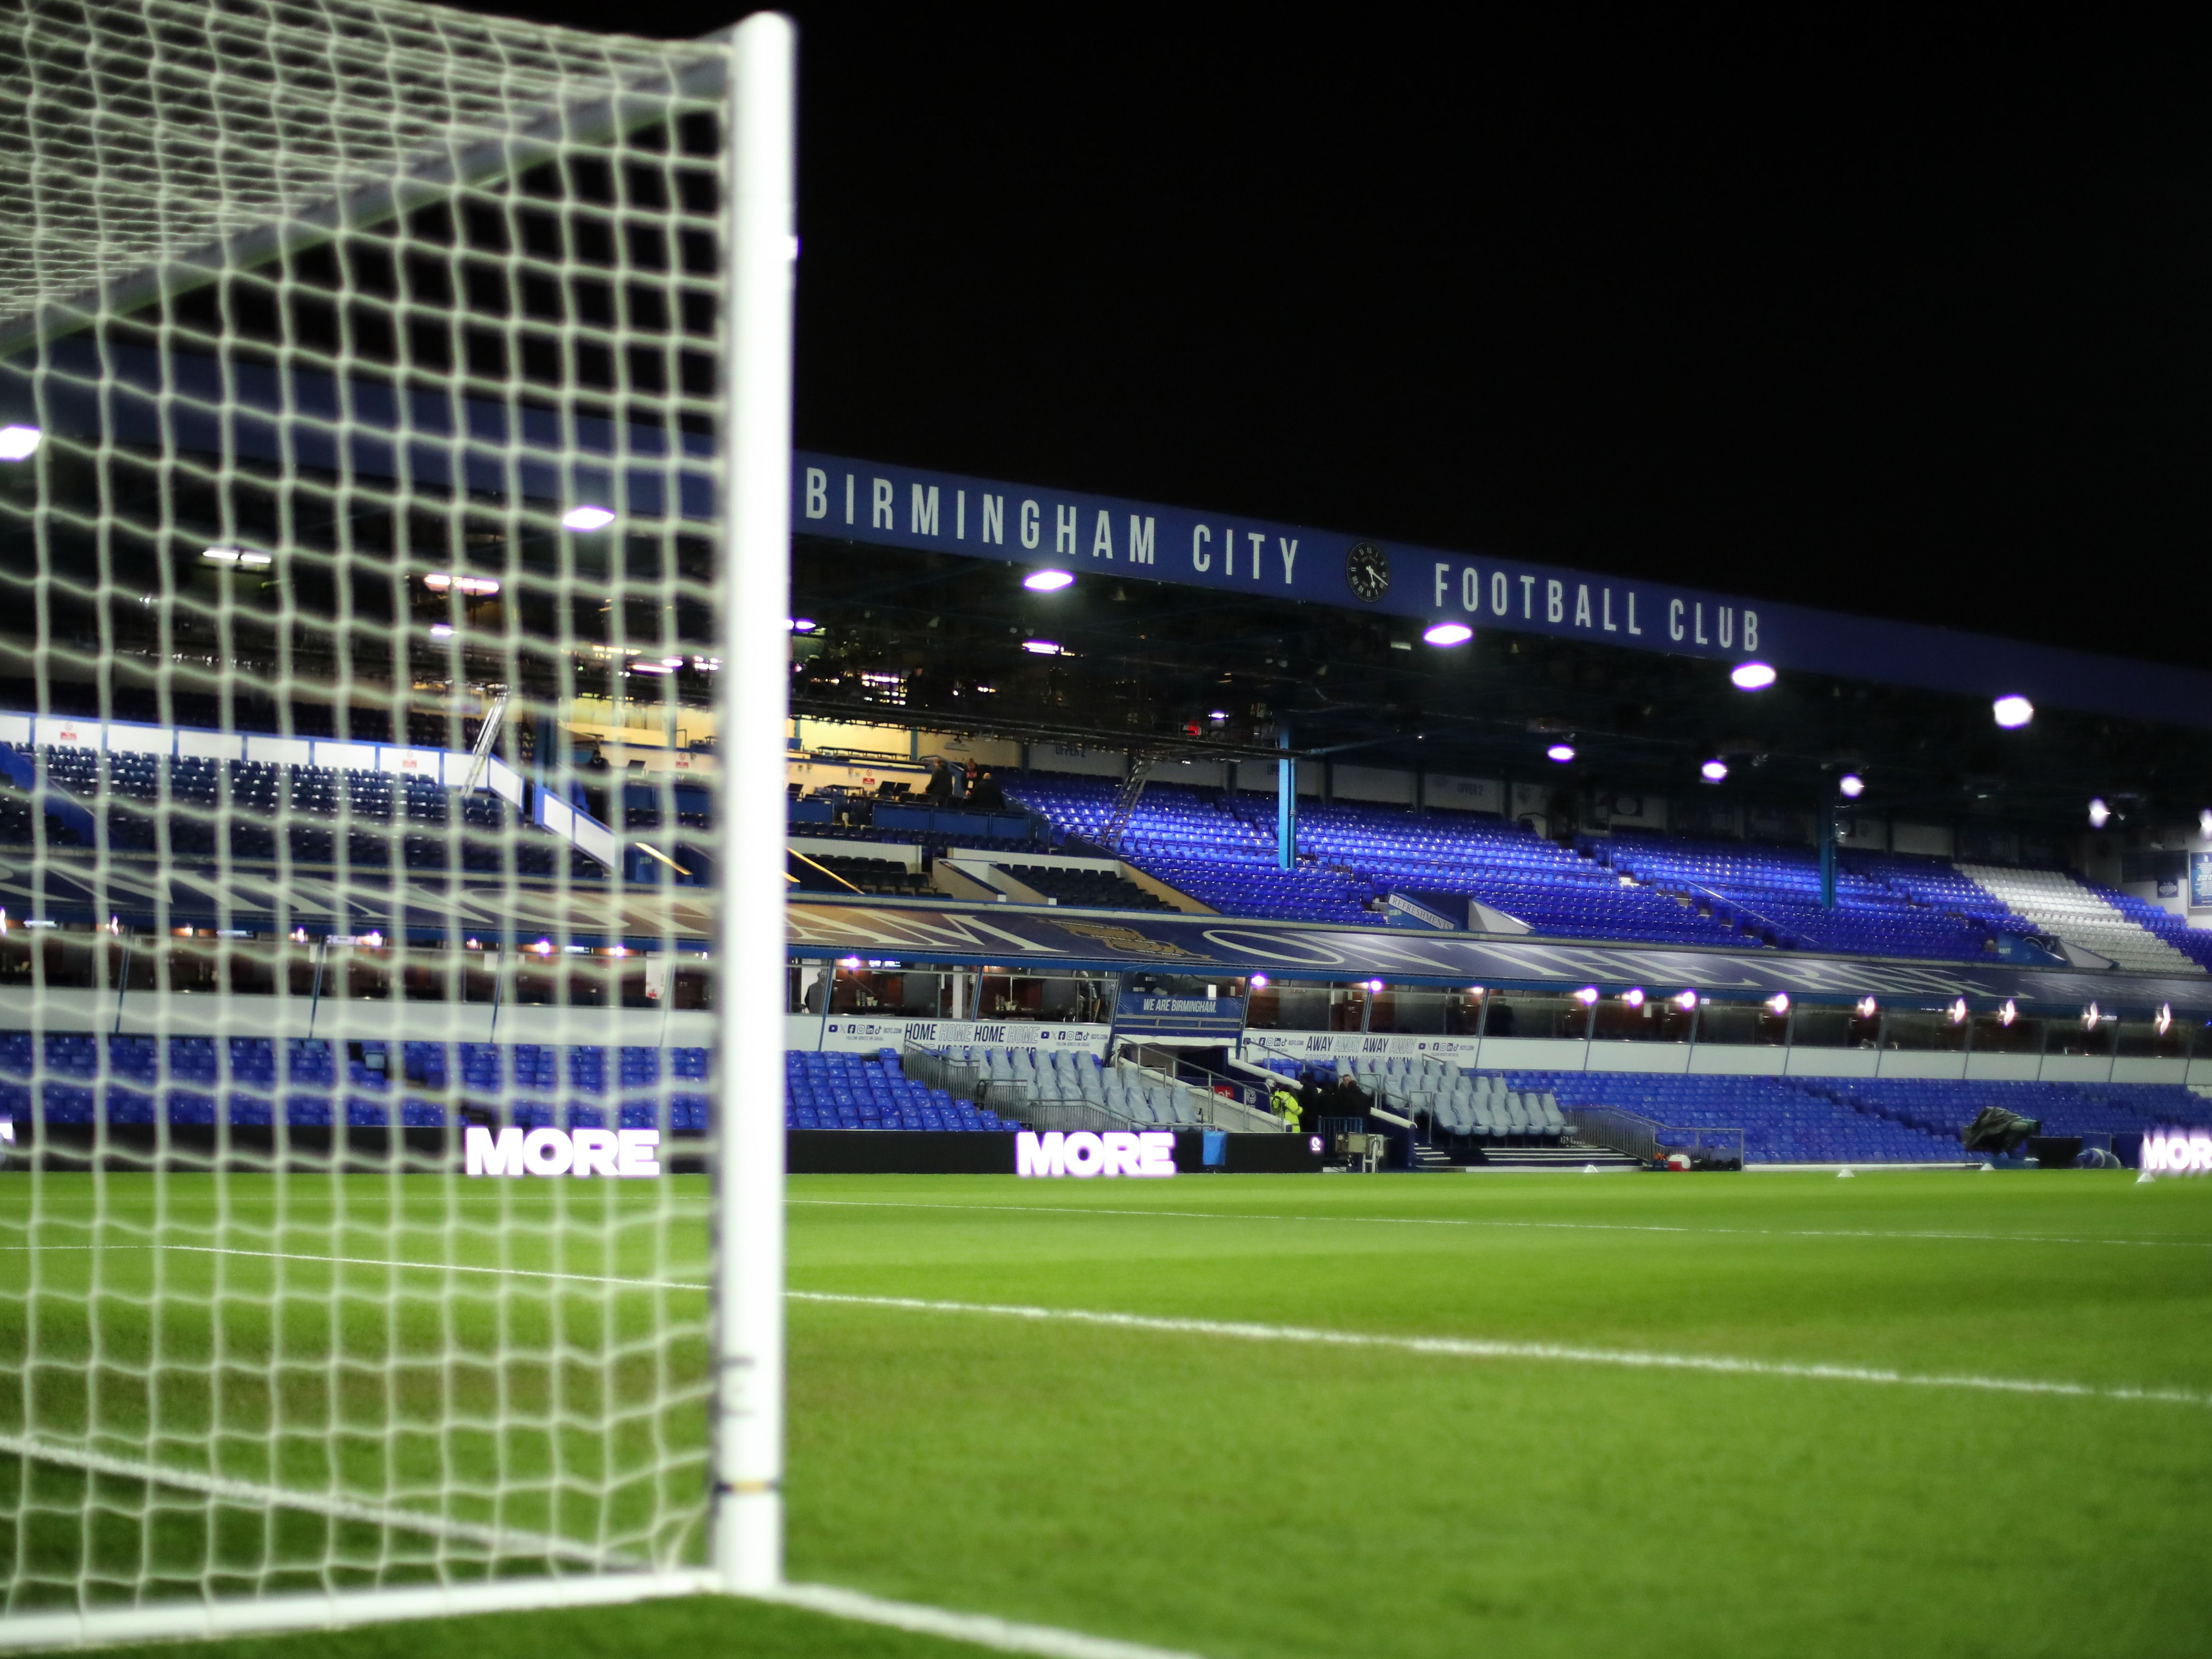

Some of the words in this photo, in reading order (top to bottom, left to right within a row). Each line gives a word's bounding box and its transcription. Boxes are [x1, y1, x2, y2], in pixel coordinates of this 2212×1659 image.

[806, 467, 1155, 565] BIRMINGHAM
[1193, 524, 1298, 584] CITY
[1436, 563, 1641, 635] FOOTBALL
[1669, 598, 1758, 652] CLUB
[1458, 783, 1477, 795] UPPER
[1478, 784, 1483, 795] 2
[1393, 897, 1450, 929] REFRESHMENTS
[1202, 929, 1462, 971] ON
[1428, 941, 1763, 987] THE
[1144, 999, 1155, 1011] WE
[1156, 999, 1170, 1012] ARE
[1171, 1000, 1217, 1013] BIRMINGHAM.
[905, 1023, 937, 1041] HOME
[939, 1024, 972, 1042] HOME
[974, 1026, 1006, 1042] HOME
[1007, 1026, 1040, 1043] HOME
[1306, 1036, 1334, 1051] AWAY
[1334, 1036, 1362, 1053] AWAY
[1362, 1038, 1389, 1053] AWAY
[1389, 1038, 1417, 1054] AWAY
[465, 1127, 660, 1176] MORE
[1017, 1131, 1176, 1177] MORE
[2143, 1138, 2212, 1169] MOR
